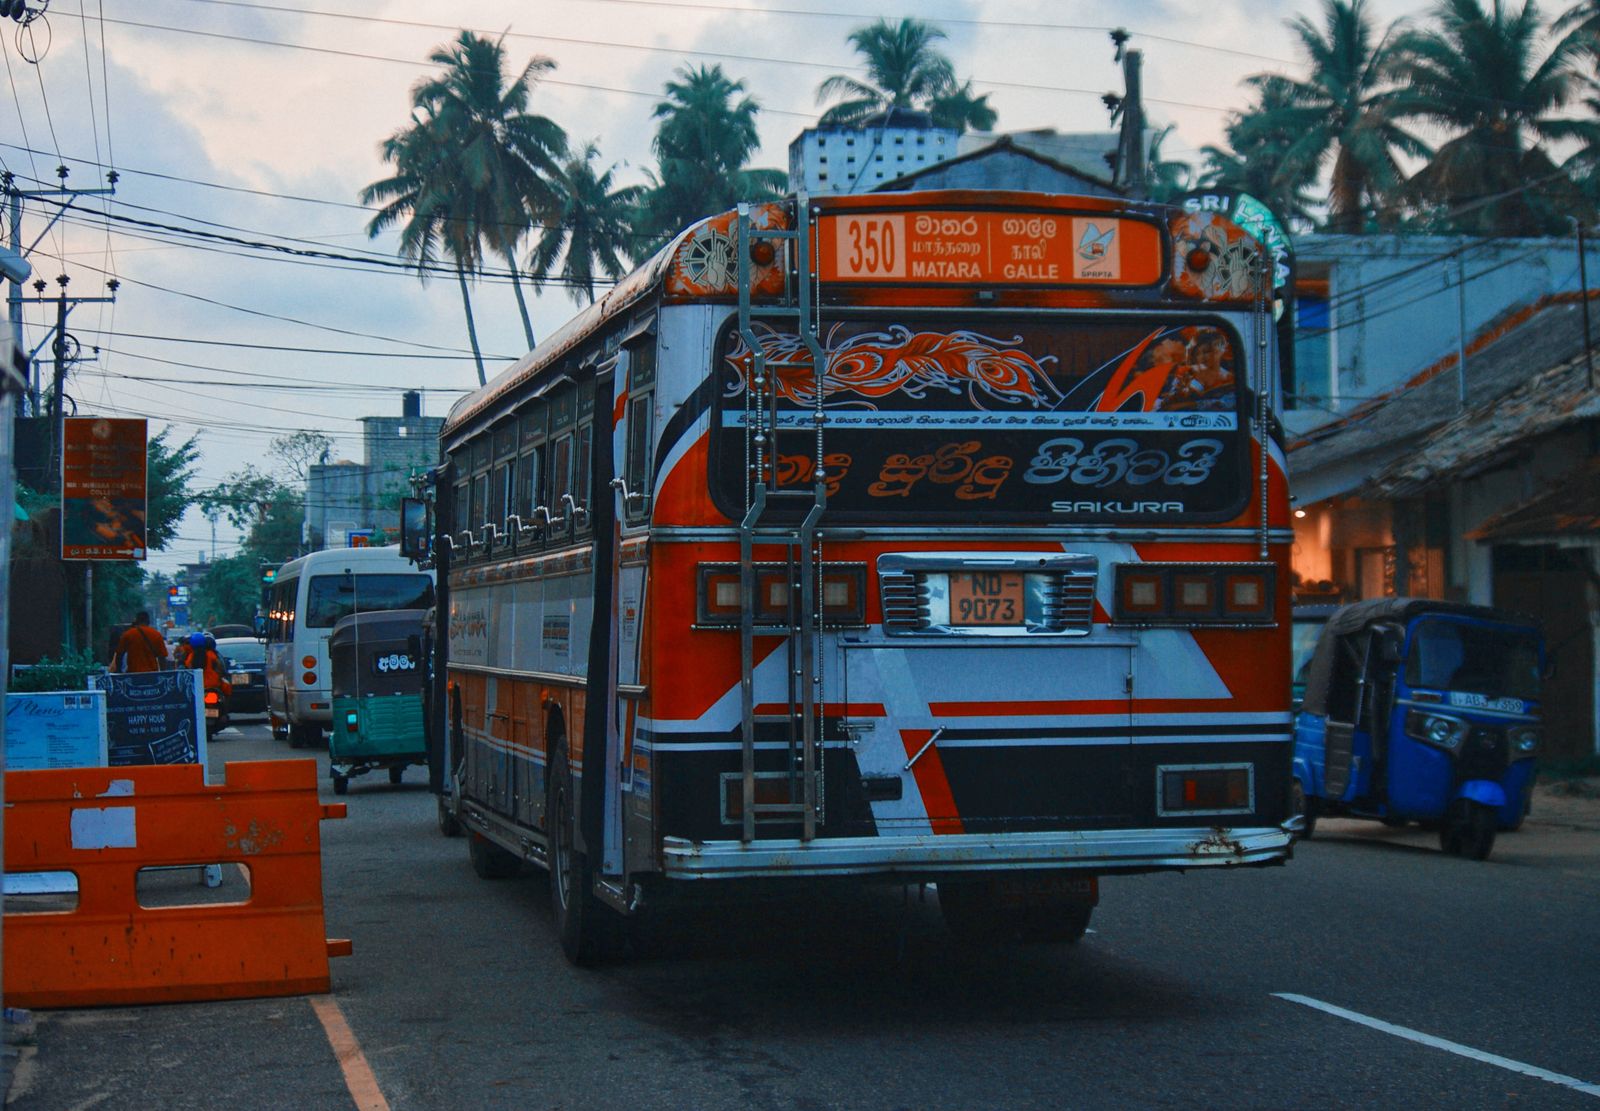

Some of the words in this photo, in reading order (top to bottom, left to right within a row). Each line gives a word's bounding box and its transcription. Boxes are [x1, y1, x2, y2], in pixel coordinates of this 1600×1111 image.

[1184, 195, 1230, 211] SRI
[915, 215, 978, 235] මාතර
[1002, 217, 1057, 238] ගාල්ල
[849, 220, 895, 274] 350
[1011, 239, 1047, 260] காலி
[912, 261, 982, 278] MATARA
[1003, 264, 1059, 279] GALLE
[1051, 501, 1184, 514] SAKURA
[959, 598, 1015, 620] 9073
[7, 698, 65, 717] Menu
[128, 715, 147, 725] HAPPY
[149, 713, 166, 723] HOUR
